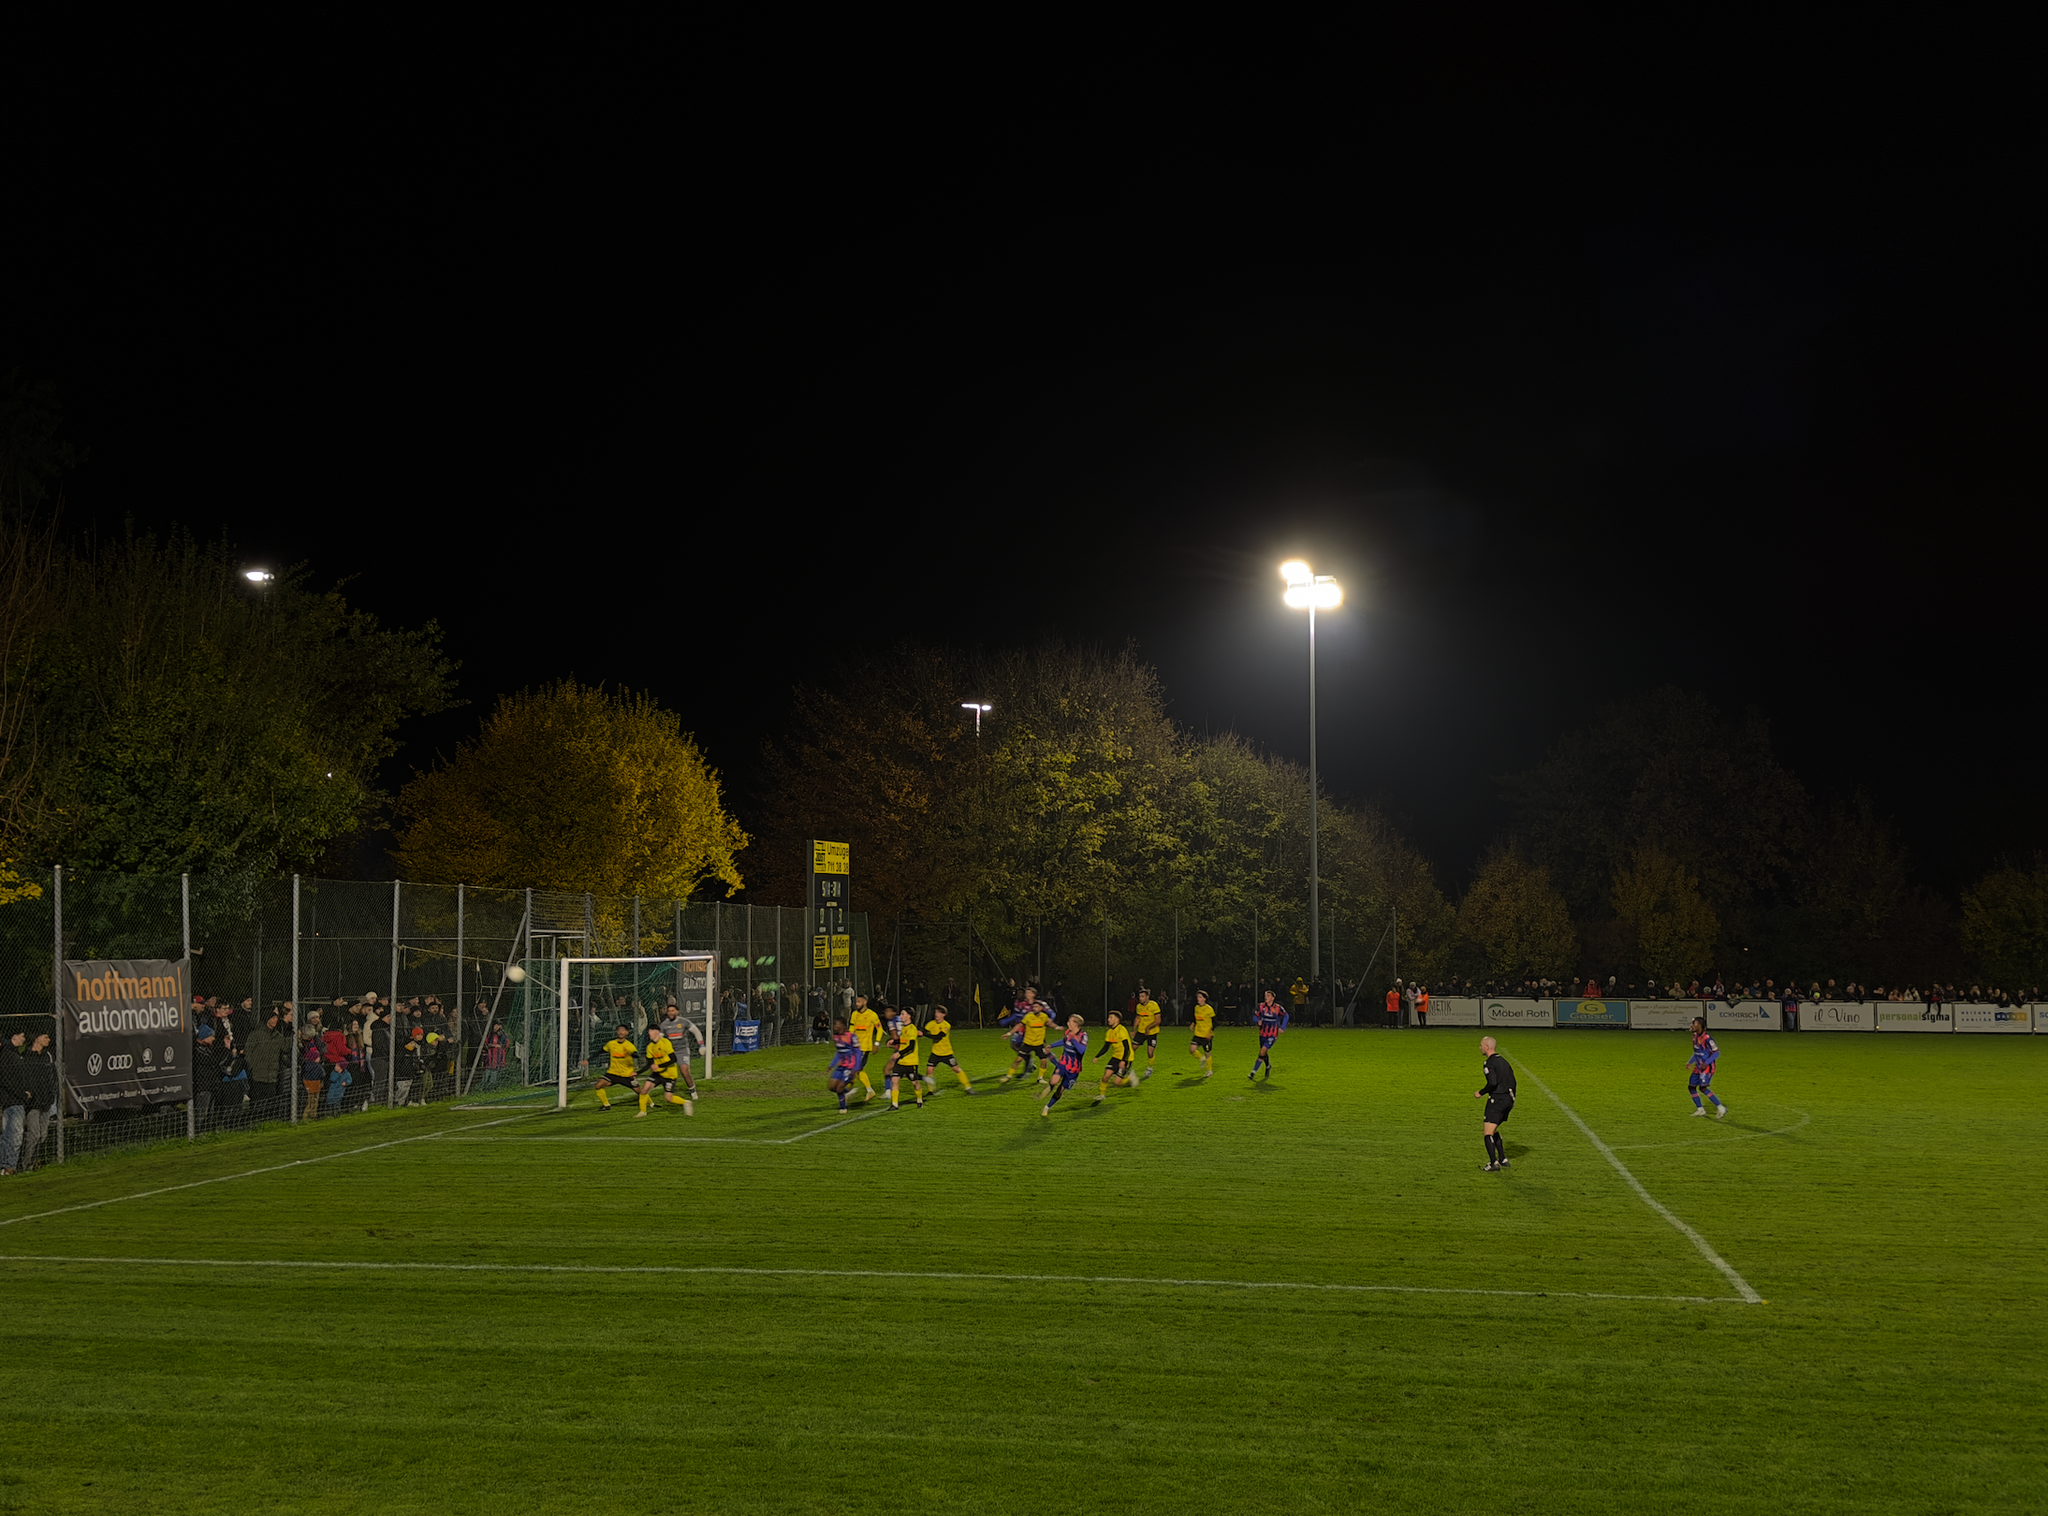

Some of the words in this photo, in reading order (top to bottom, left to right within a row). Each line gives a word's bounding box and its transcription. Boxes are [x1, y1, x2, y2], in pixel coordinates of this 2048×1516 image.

[76, 970, 177, 1001] hoffmann
[79, 1001, 179, 1033] automobile
[1492, 1009, 1524, 1018] Möbel
[1526, 1009, 1550, 1018] Roth
[1569, 1012, 1615, 1020] Gasser
[1827, 1008, 1861, 1023] Vino
